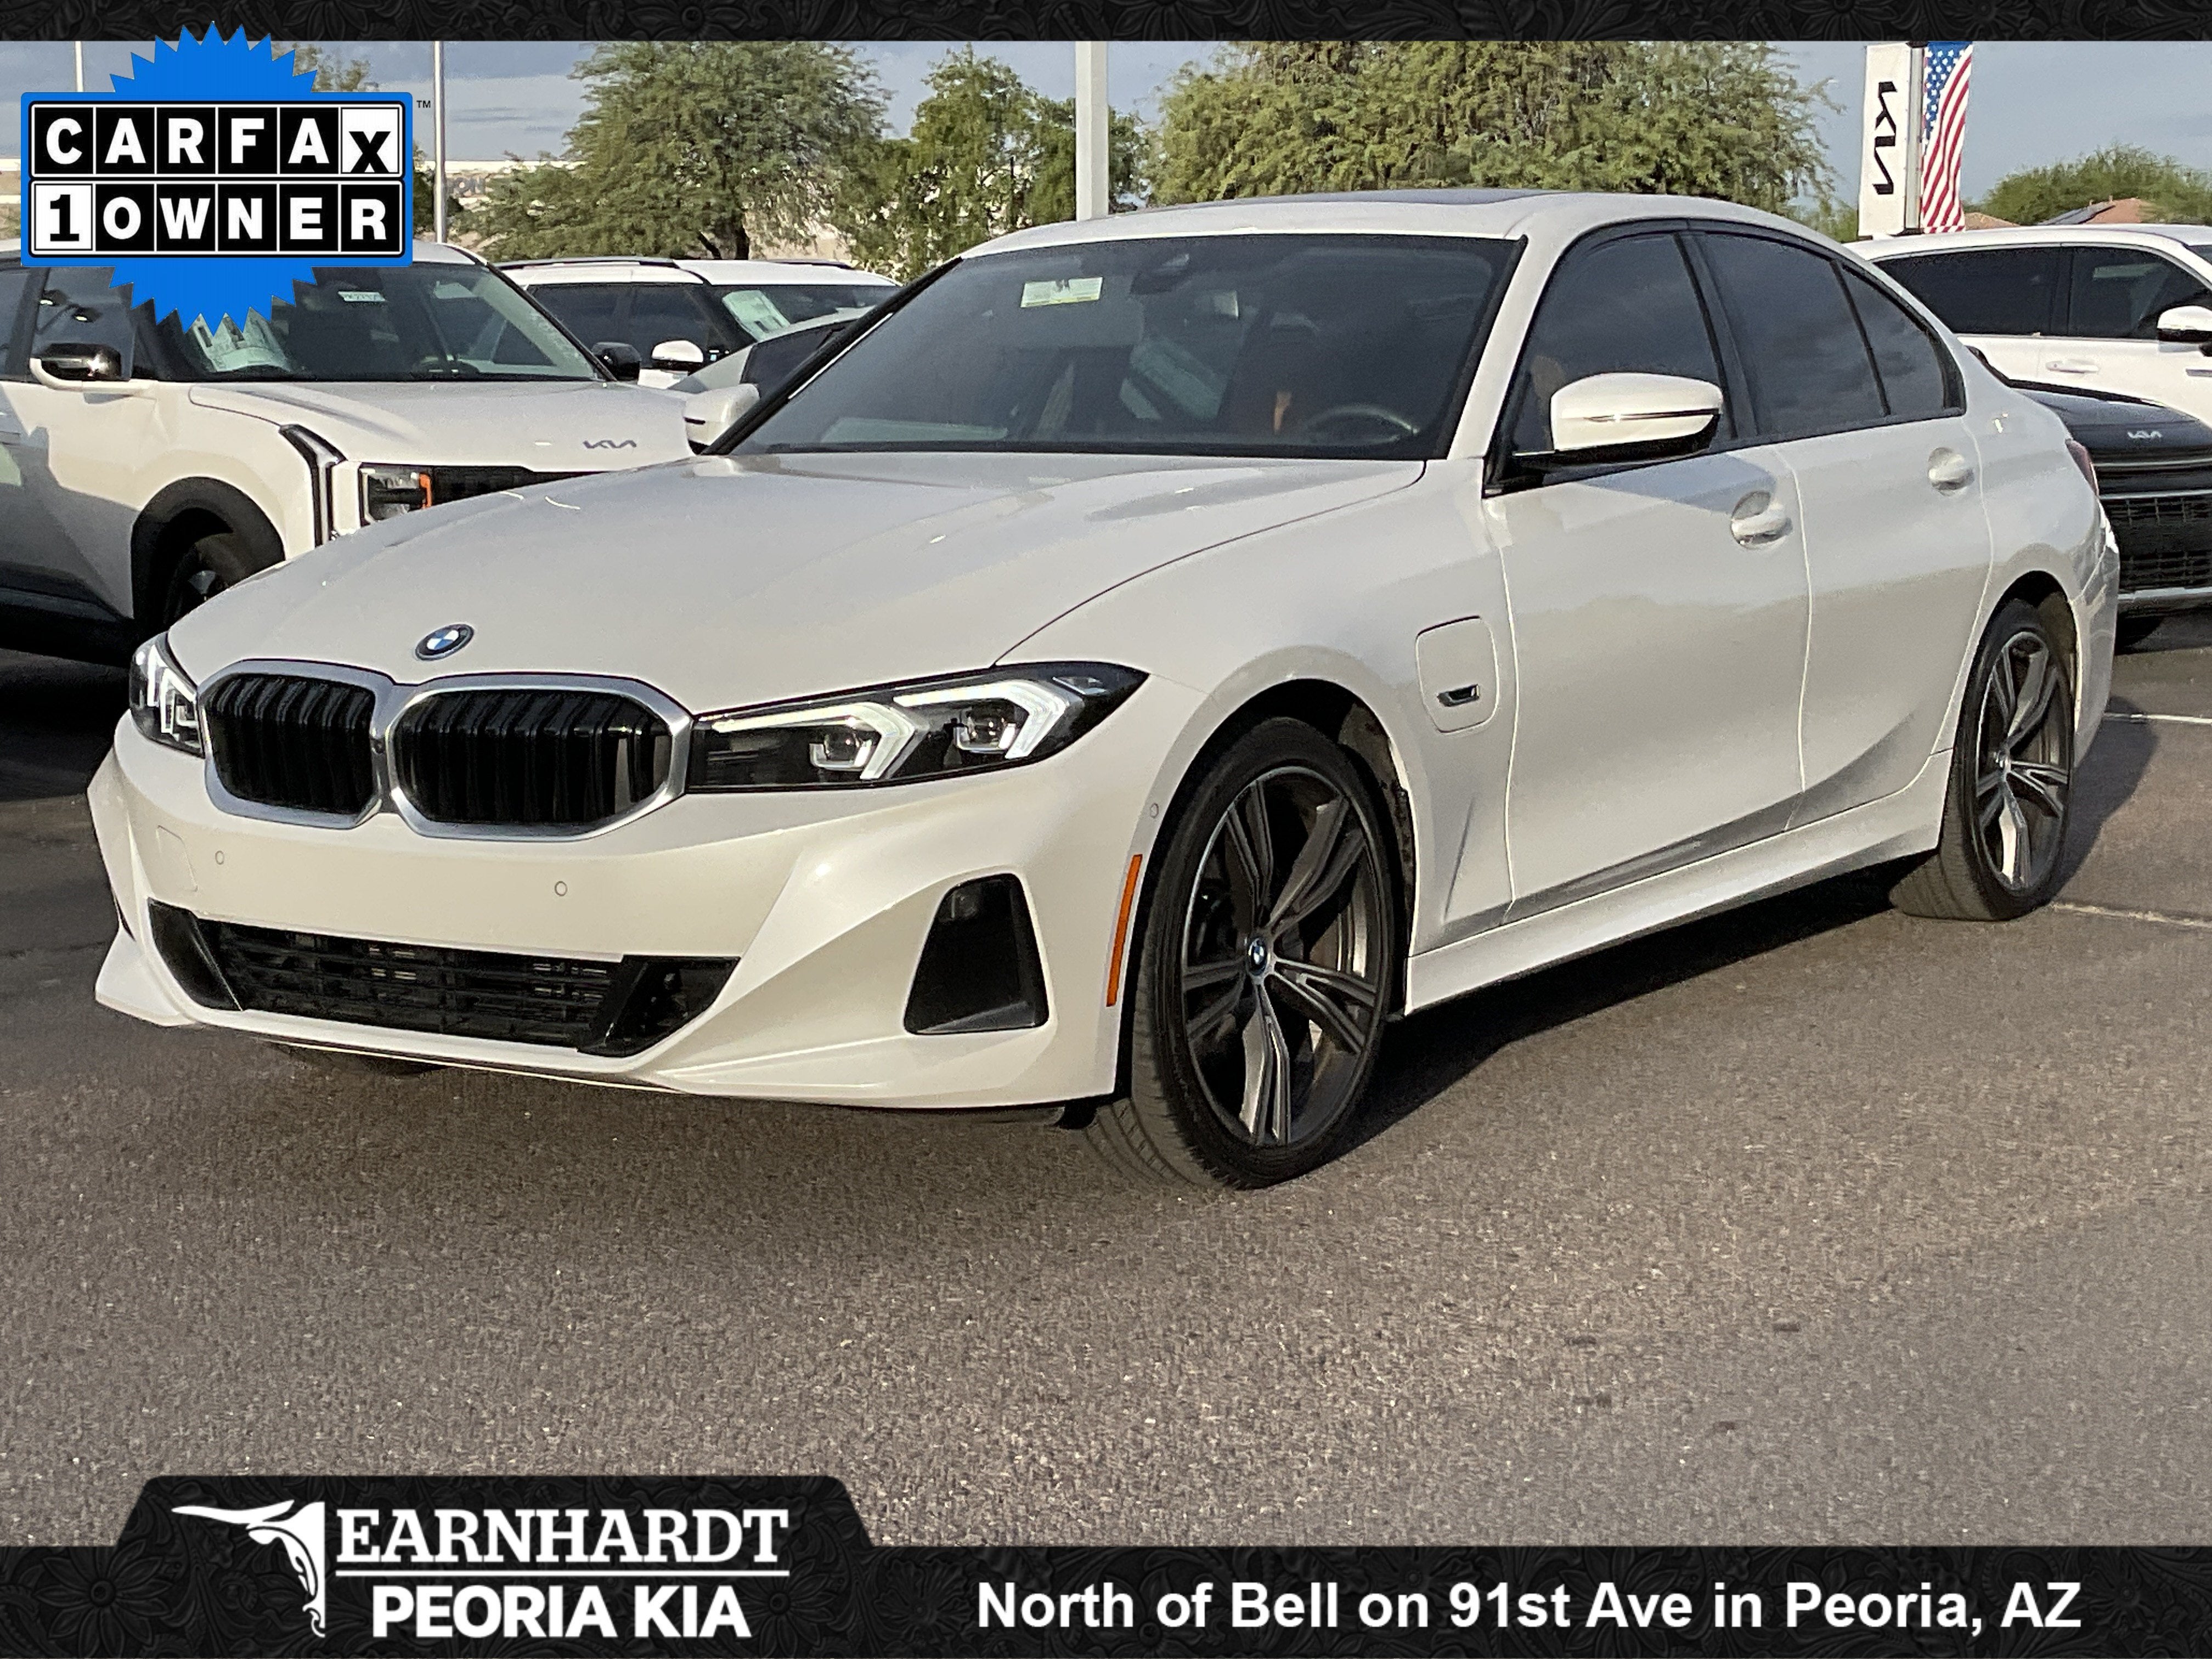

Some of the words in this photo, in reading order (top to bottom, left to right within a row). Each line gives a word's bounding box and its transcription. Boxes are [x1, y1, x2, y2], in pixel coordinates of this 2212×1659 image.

[1873, 81, 1898, 195] KIA
[2127, 430, 2162, 439] KIA
[582, 439, 637, 449] KIA
